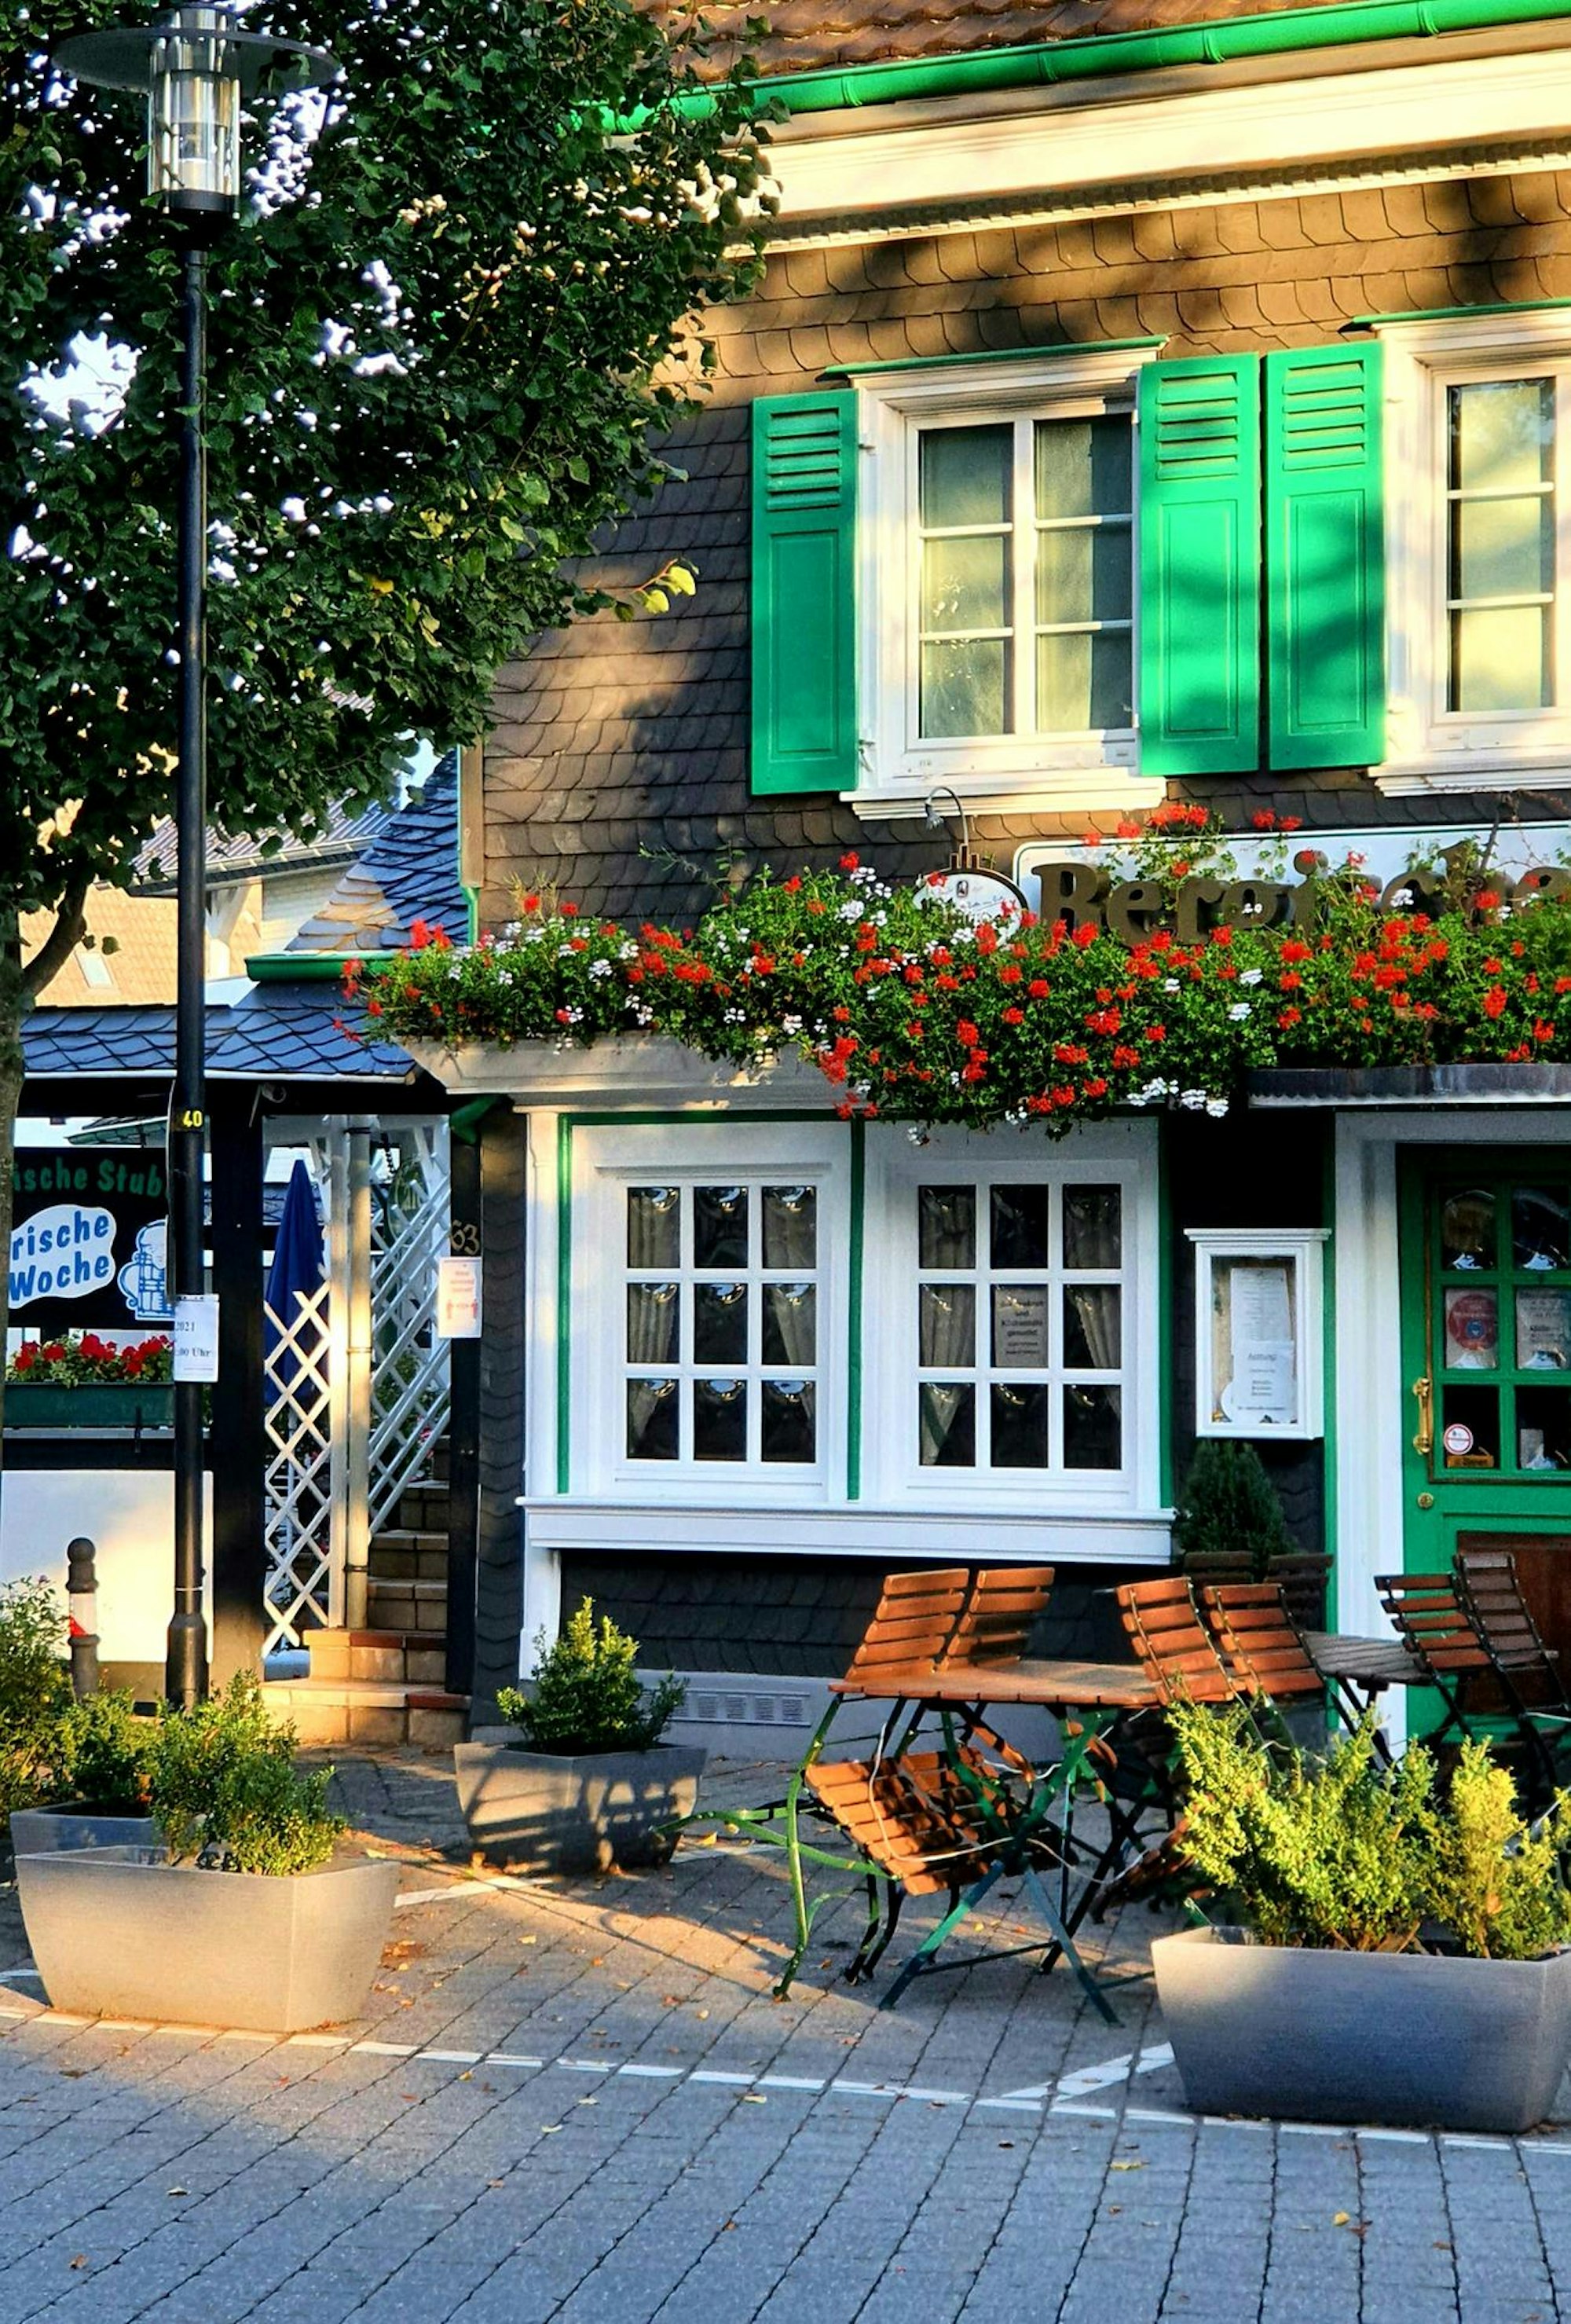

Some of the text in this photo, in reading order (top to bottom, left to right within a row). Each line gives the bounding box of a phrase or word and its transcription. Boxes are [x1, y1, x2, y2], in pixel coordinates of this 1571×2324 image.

[182, 1110, 203, 1128] 40
[96, 1157, 169, 1198] Stub
[9, 1251, 110, 1301] Woche
[192, 1347, 211, 1357] Uhr
